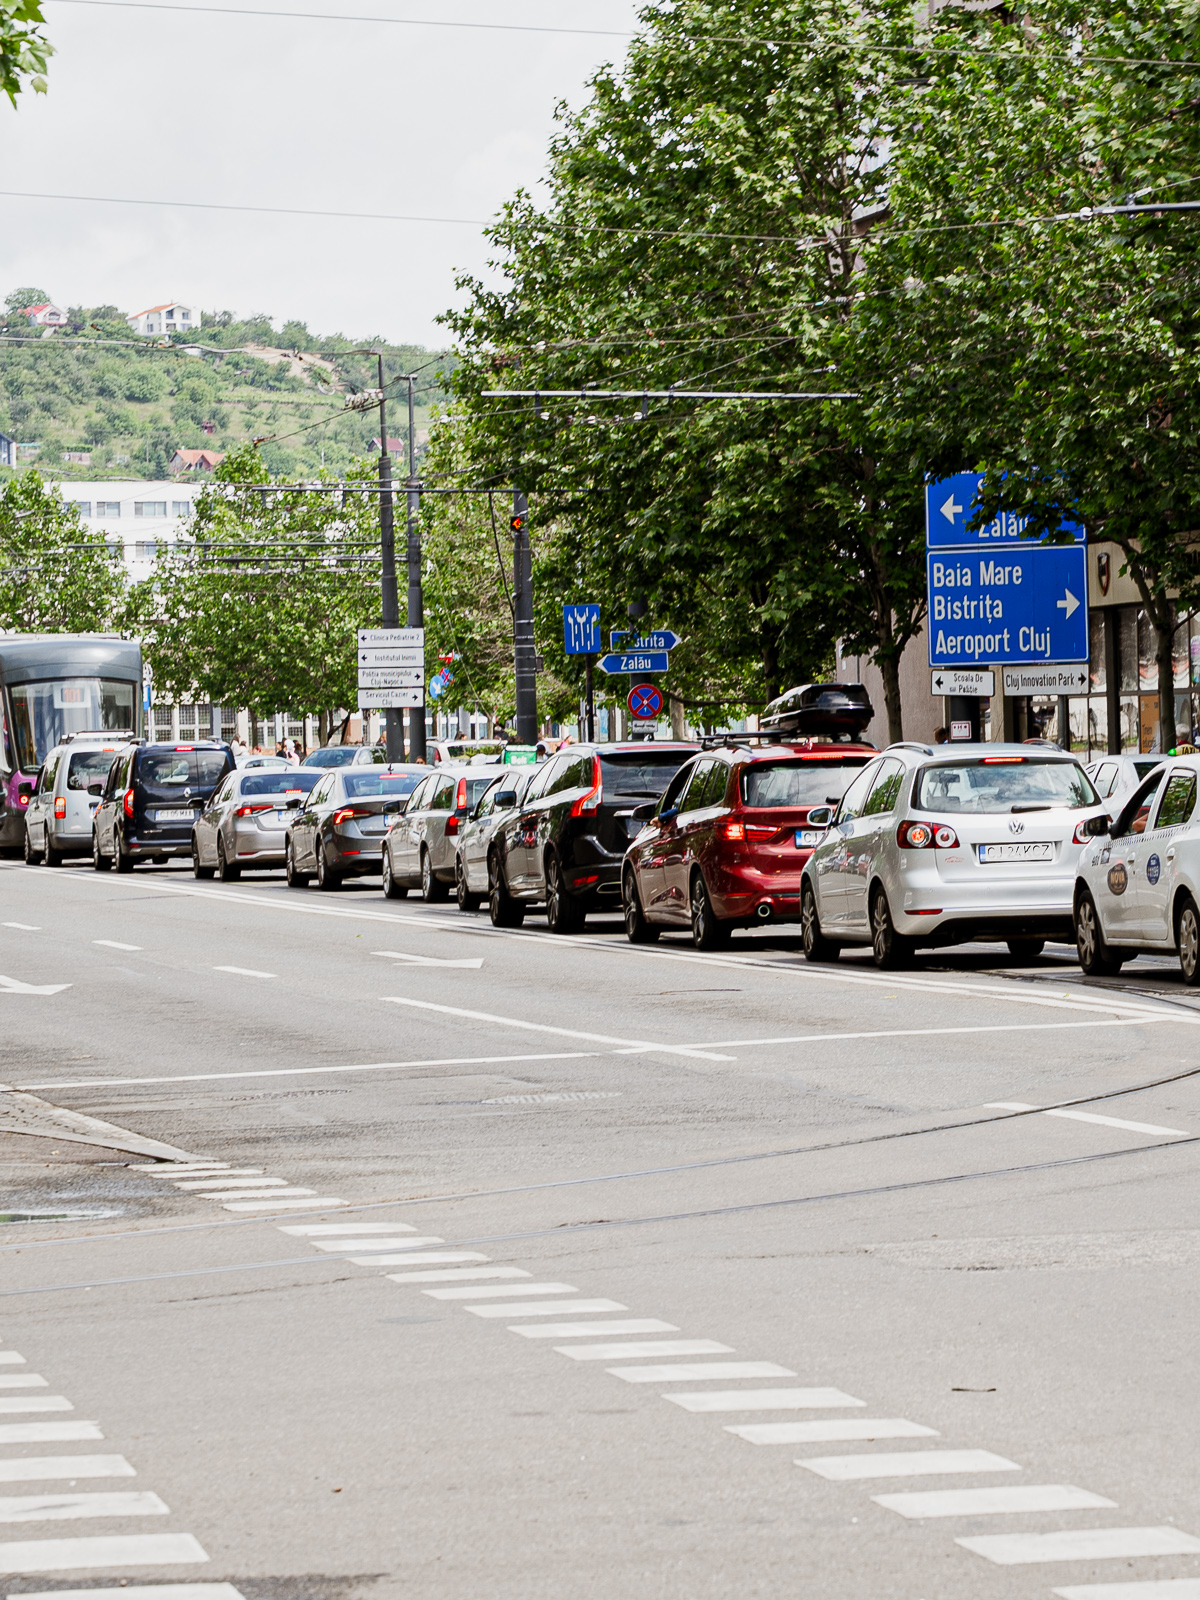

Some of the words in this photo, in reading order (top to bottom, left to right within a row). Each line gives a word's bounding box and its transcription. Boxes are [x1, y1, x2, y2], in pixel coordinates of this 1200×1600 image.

[933, 562, 971, 588] Baia
[979, 560, 1022, 586] Mare
[934, 594, 1002, 624] Bistrița
[935, 628, 1010, 660] Aeroport
[1018, 626, 1051, 658] Cluj
[620, 656, 652, 670] Zalău
[370, 678, 403, 687] Cluj-Napoca
[975, 673, 984, 682] De
[1005, 674, 1020, 690] Cluj
[1020, 673, 1057, 687] Innovation
[1058, 673, 1075, 686] Park
[63, 689, 81, 702] 101
[381, 699, 392, 707] Cluj
[1182, 746, 1196, 755] TAXI
[803, 832, 818, 843] CJ
[987, 846, 1003, 859] CJ
[1110, 871, 1125, 884] NOVA
